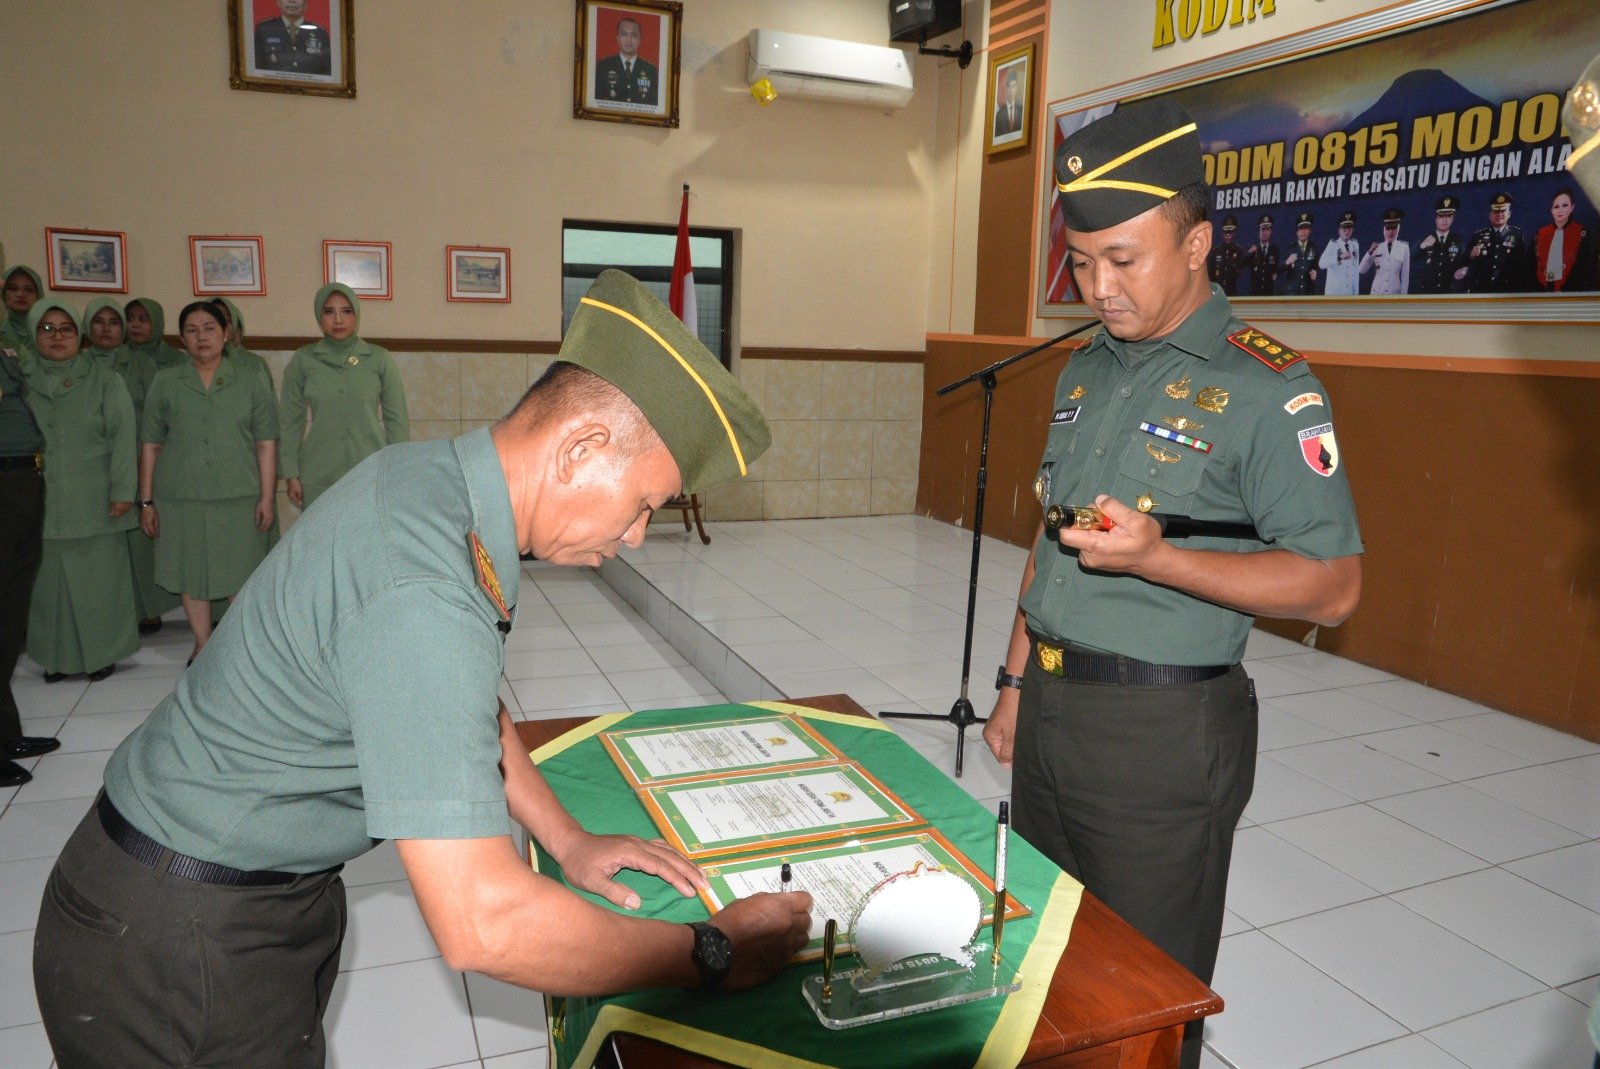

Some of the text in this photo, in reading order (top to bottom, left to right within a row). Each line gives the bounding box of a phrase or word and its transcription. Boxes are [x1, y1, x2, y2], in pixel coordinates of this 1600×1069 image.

[1202, 90, 1570, 186] ODIM 0815 MOJO
[1216, 143, 1572, 210] BERSAMA RAKYAT BERSATU DENGAN ALA
